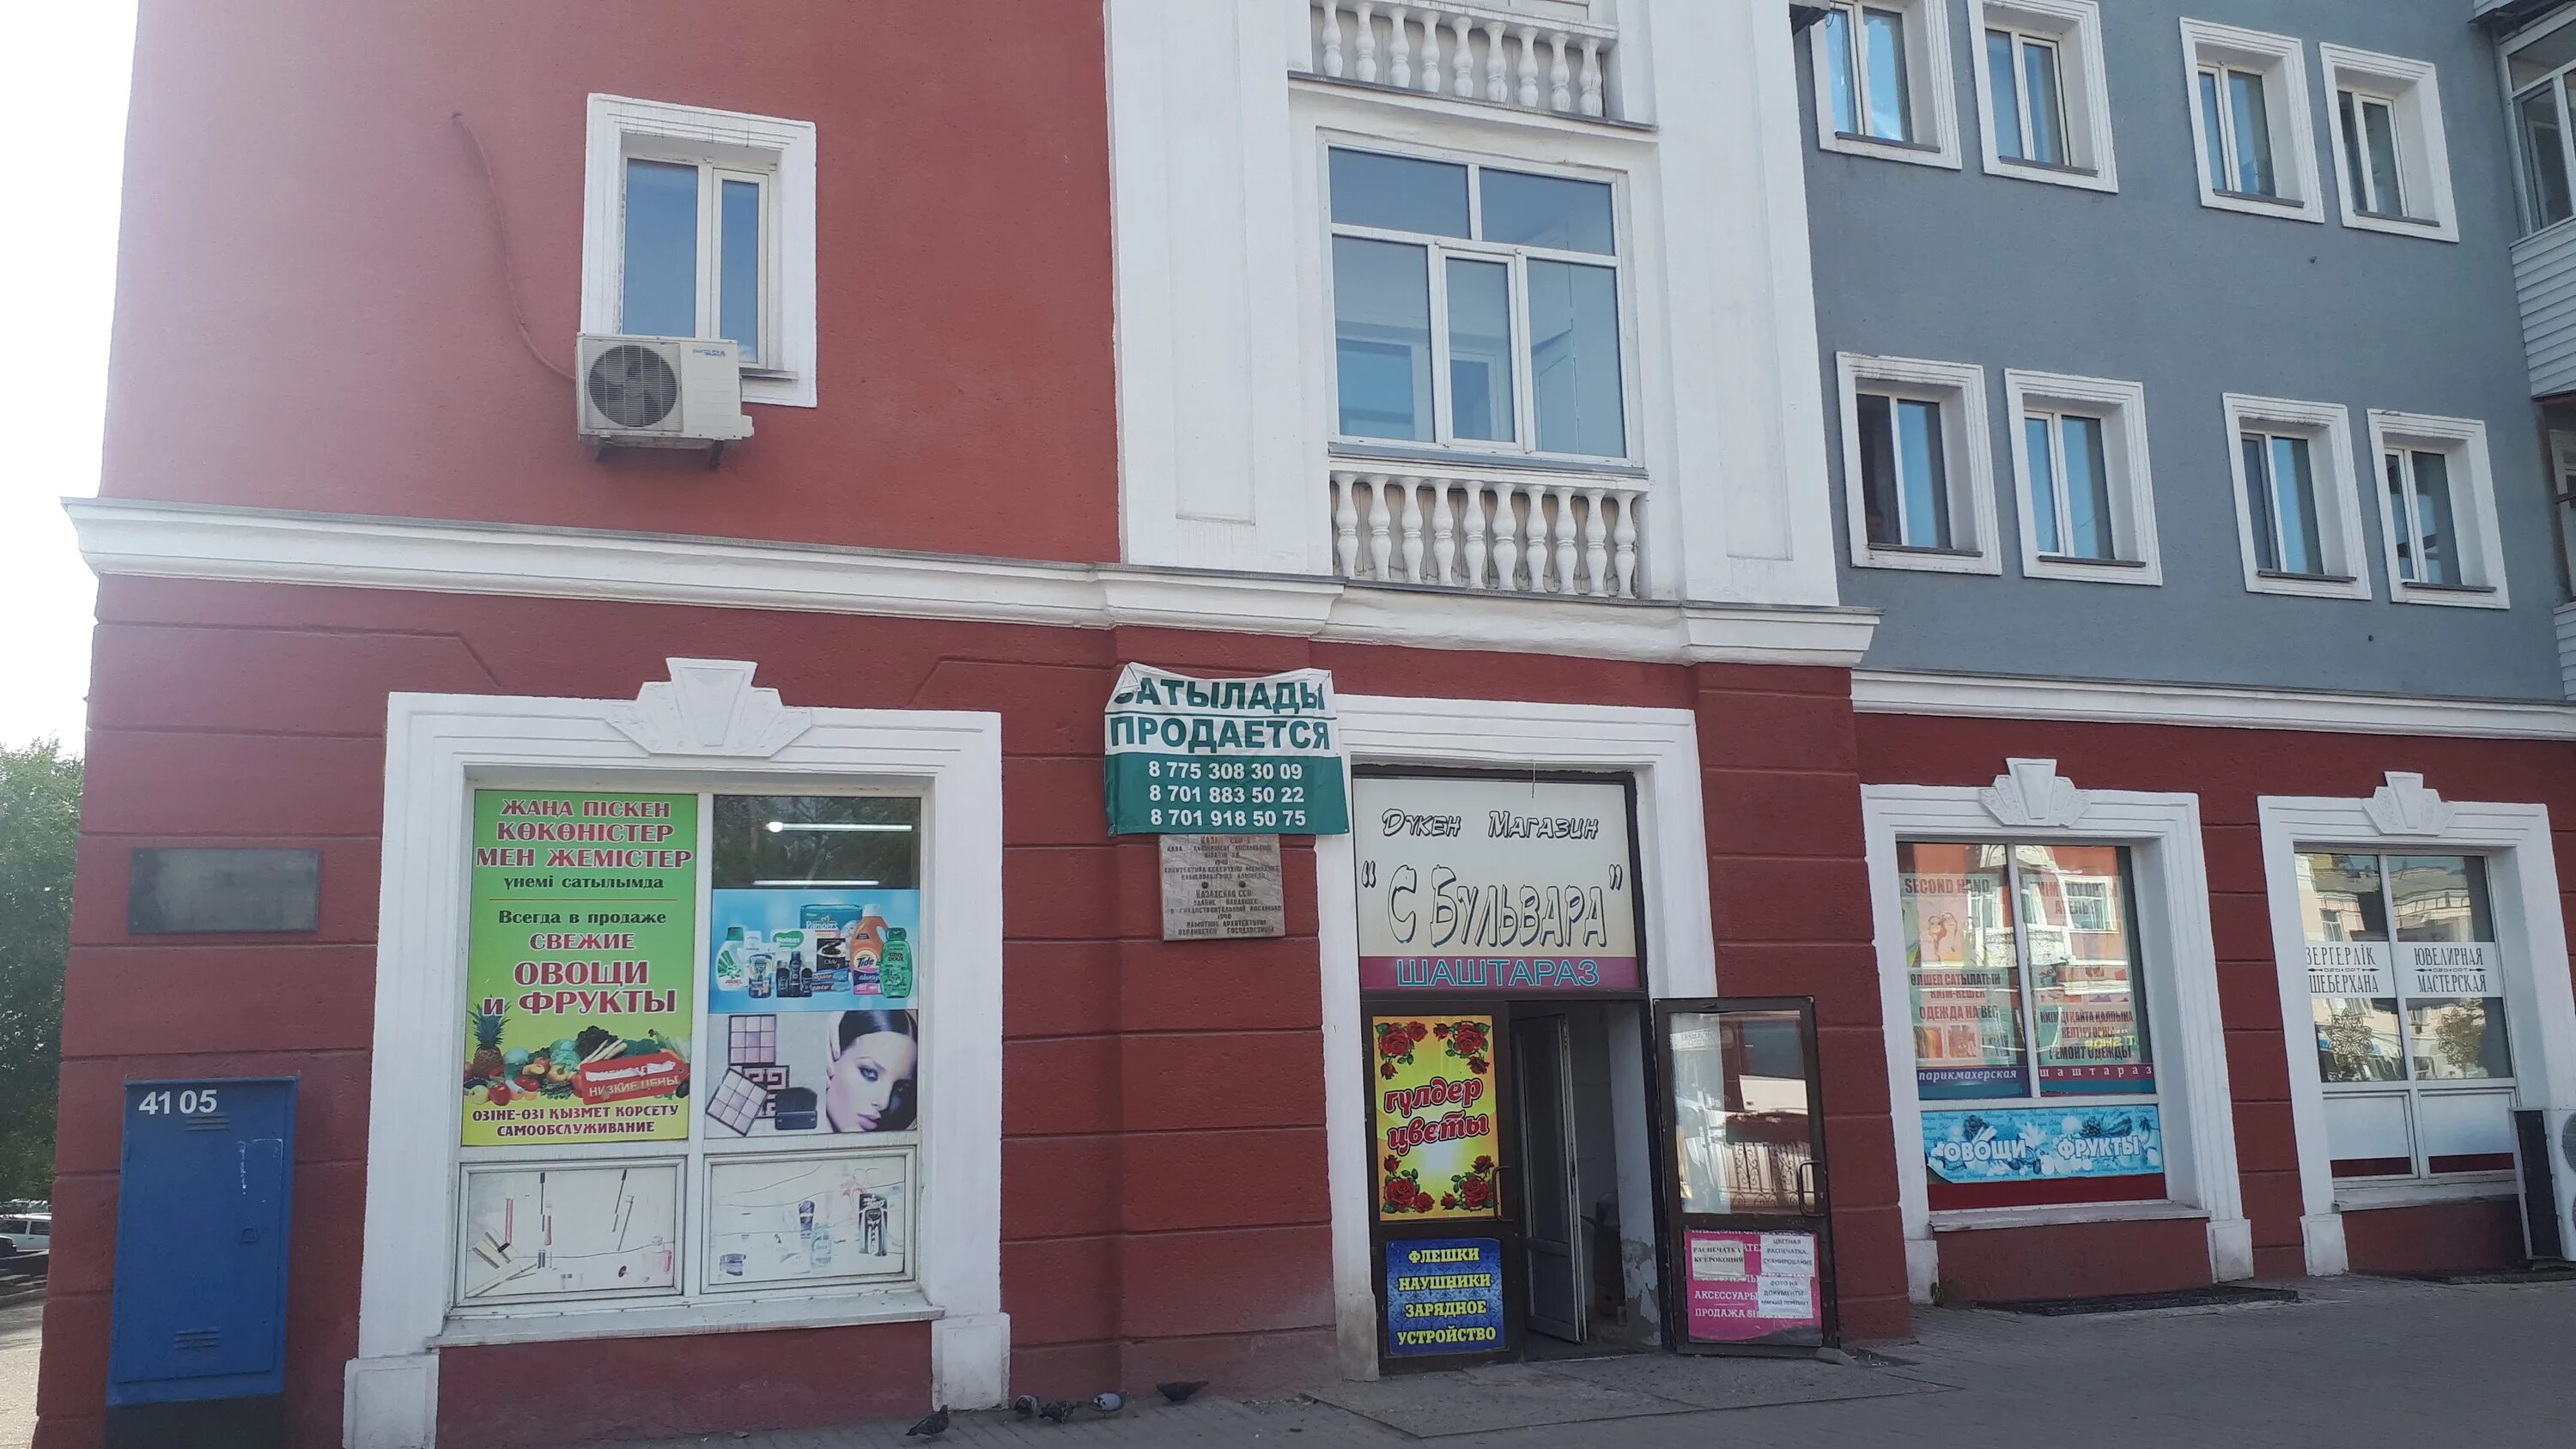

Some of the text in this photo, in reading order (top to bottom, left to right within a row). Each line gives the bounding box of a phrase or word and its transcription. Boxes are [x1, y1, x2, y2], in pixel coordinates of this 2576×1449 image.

[1110, 716, 1330, 753] ПРОДАЕТСЯ
[1148, 761, 1303, 780] 8 775 308 30 09
[1149, 785, 1304, 803] 8 701 883 50 22
[501, 799, 671, 818] ЖАҢА ПІСКЕН
[1151, 809, 1306, 827] 8 701 918 50 75
[496, 822, 675, 843] КӨКӨНІСТЕР
[476, 848, 692, 869] МЕН ЖЕМІСТЕР
[504, 876, 665, 889] үнемі сатылымда
[1904, 878, 1953, 894] SECOND
[499, 910, 667, 925] Всегда в продаже
[530, 933, 635, 950] СВЕЖИЕ
[856, 957, 875, 968] Tide
[2414, 947, 2484, 966] ЮВЕЛИРНАЯ
[513, 961, 648, 987] ОВОЩИ
[1396, 959, 1600, 987] ШАШТАРАЗ
[1945, 973, 2001, 985] САТЫЛАТЫН
[2309, 974, 2379, 993] ШЕБЕРХАНА
[2417, 974, 2488, 993] МАСТЕРСКАЯ
[518, 990, 677, 1016] ФРУКТЫ
[1919, 1006, 1963, 1022] ОДЕЖДА
[1965, 1005, 1978, 1019] НА
[1918, 1069, 2017, 1082] парикмахерская
[496, 1121, 655, 1137] САМООБСЛУЖИВАНИЕ
[1388, 1110, 1490, 1157] цветы
[1942, 1135, 2141, 1162] ОВОЩИ ФРУКТЫ
[1408, 1247, 1480, 1264] ФЛЕШКИ
[1398, 1273, 1492, 1291] НАУШНИКИ
[1405, 1300, 1487, 1319] ЗАРЯДНОЕ
[1695, 1308, 1746, 1318] ПРОДАЖА
[1397, 1325, 1497, 1345] УСТРОЙСТВО
